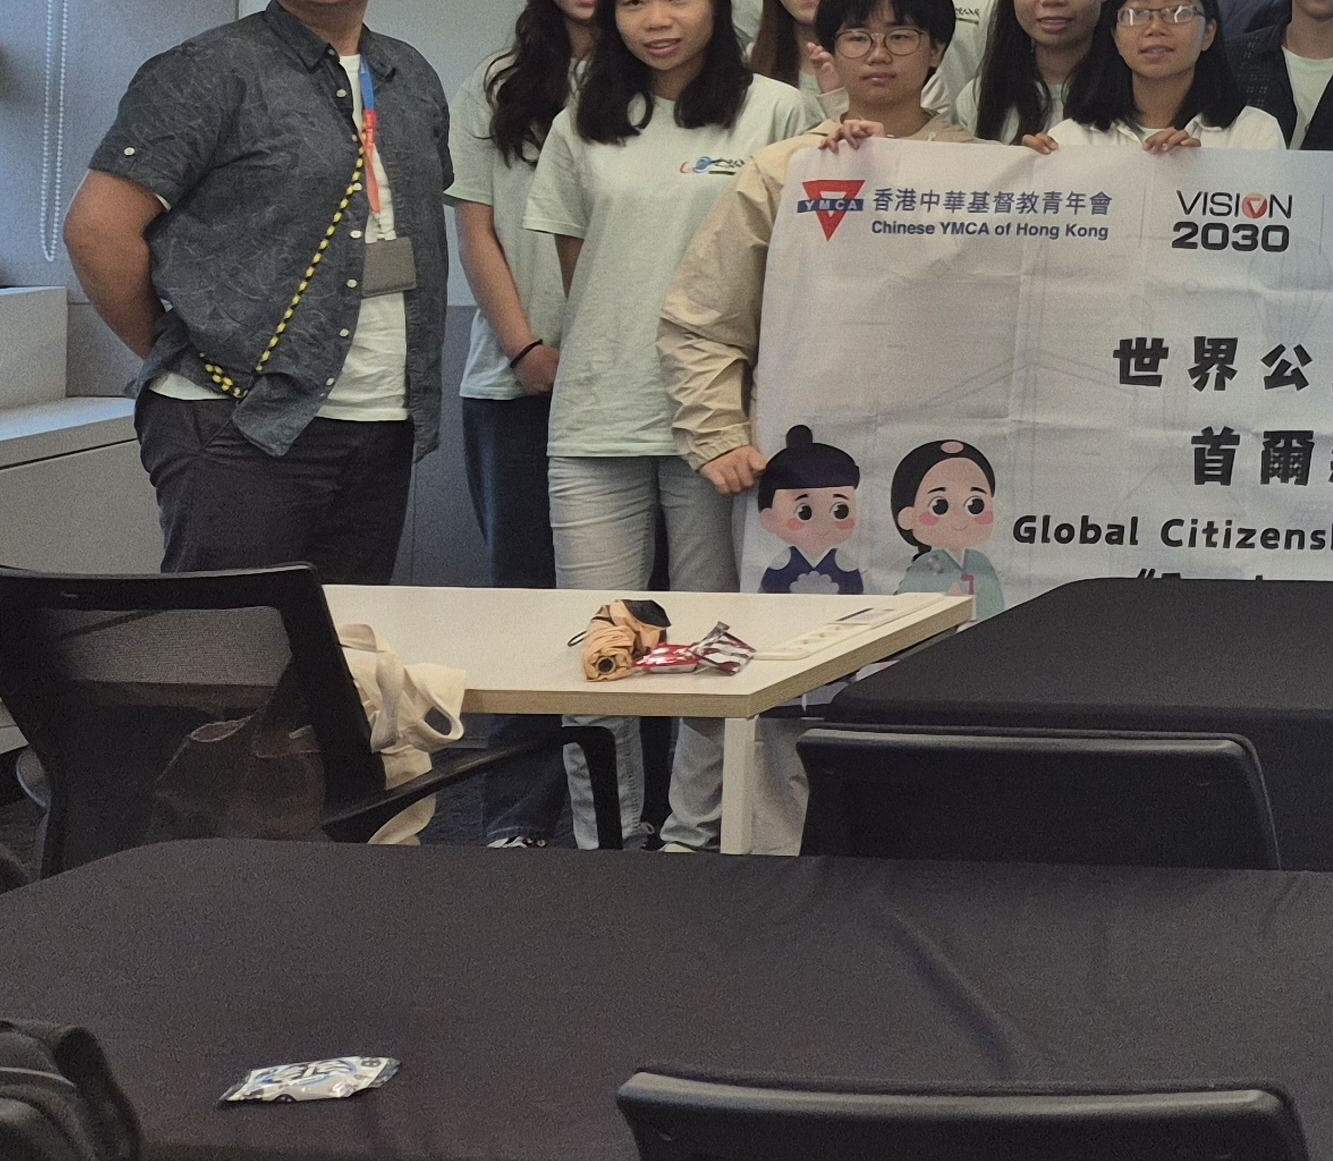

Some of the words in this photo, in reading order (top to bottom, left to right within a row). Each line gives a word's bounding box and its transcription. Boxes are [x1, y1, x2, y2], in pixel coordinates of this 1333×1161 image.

[804, 199, 858, 212] YMCA
[873, 187, 1113, 216] 香港中華基督教青年會
[1177, 189, 1293, 219] VISION
[871, 220, 936, 235] Chinese
[939, 221, 990, 236] YMCA
[994, 222, 1012, 236] of
[1016, 222, 1060, 240] Hong
[1065, 223, 1110, 241] Kong
[1171, 221, 1290, 253] 2030
[1012, 514, 1139, 546] Global
